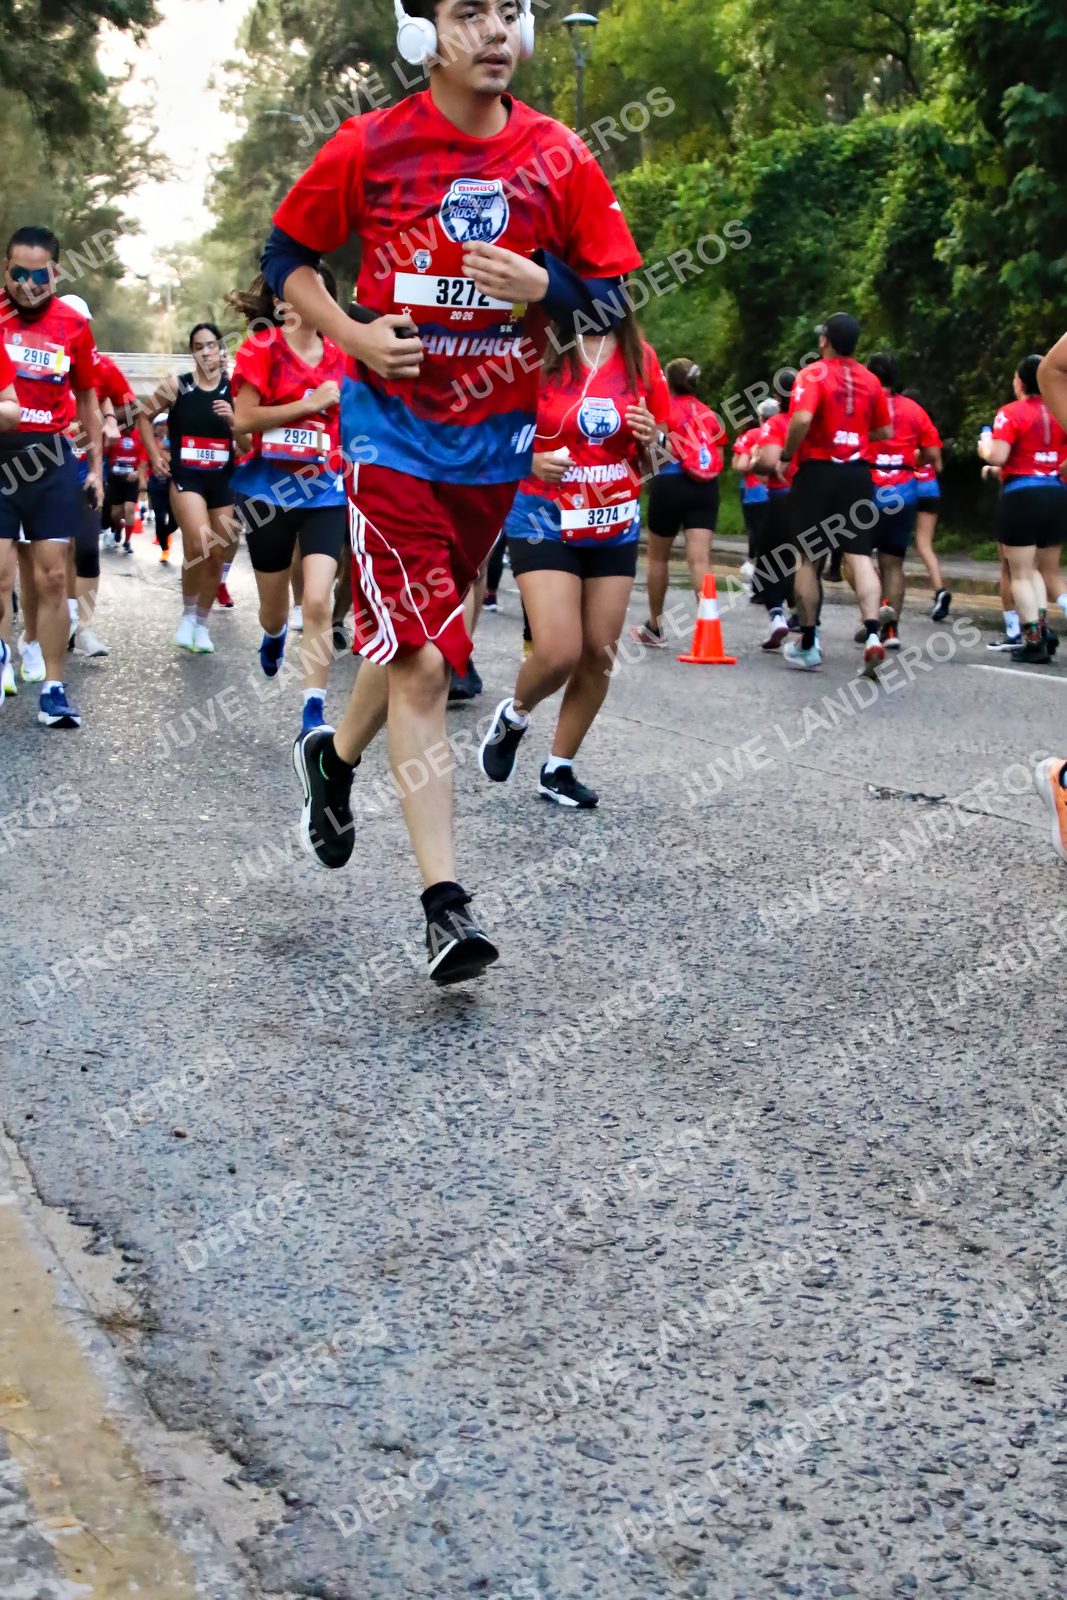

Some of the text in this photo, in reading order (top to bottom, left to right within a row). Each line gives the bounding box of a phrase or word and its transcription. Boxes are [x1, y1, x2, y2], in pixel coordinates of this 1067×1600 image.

[449, 206, 478, 219] Race
[23, 348, 51, 366] 2916
[284, 429, 313, 446] 2921
[587, 506, 619, 526] 3274
